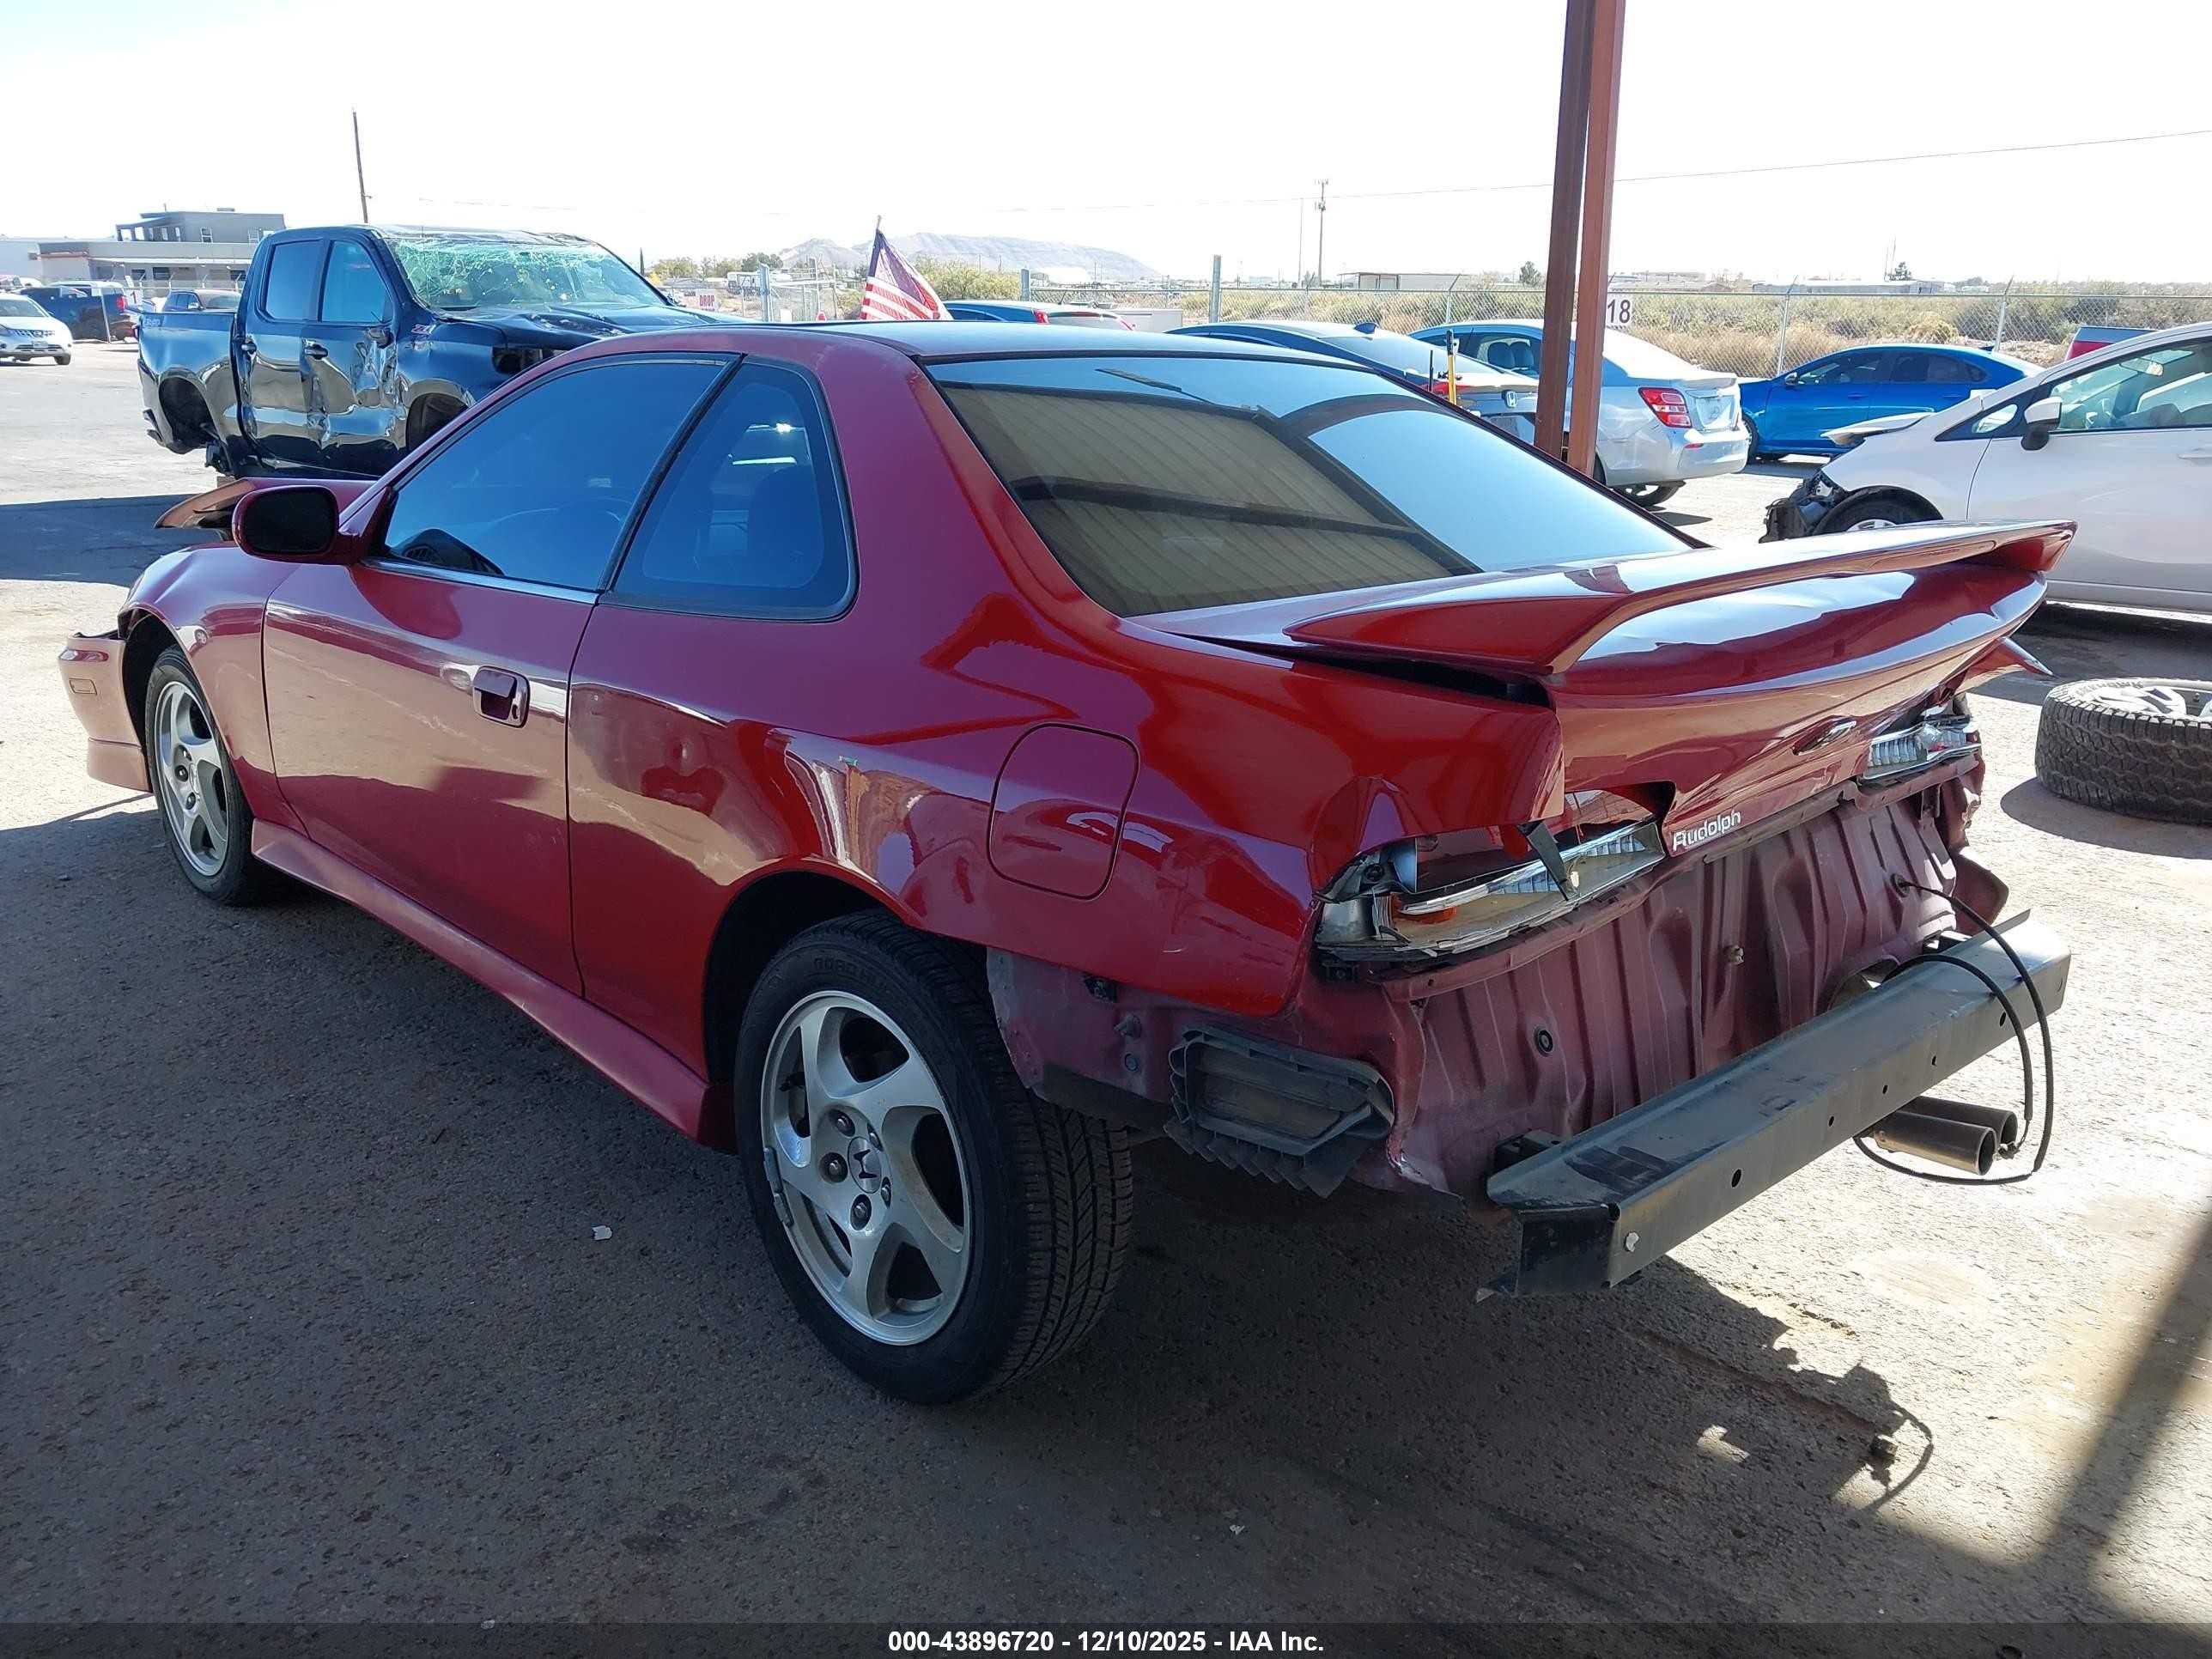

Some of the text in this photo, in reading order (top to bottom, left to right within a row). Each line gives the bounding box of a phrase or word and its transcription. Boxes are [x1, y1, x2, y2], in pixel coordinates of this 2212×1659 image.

[699, 295, 715, 307] DROP
[1607, 299, 1631, 324] 18
[1673, 809, 1741, 852] Rudolph
